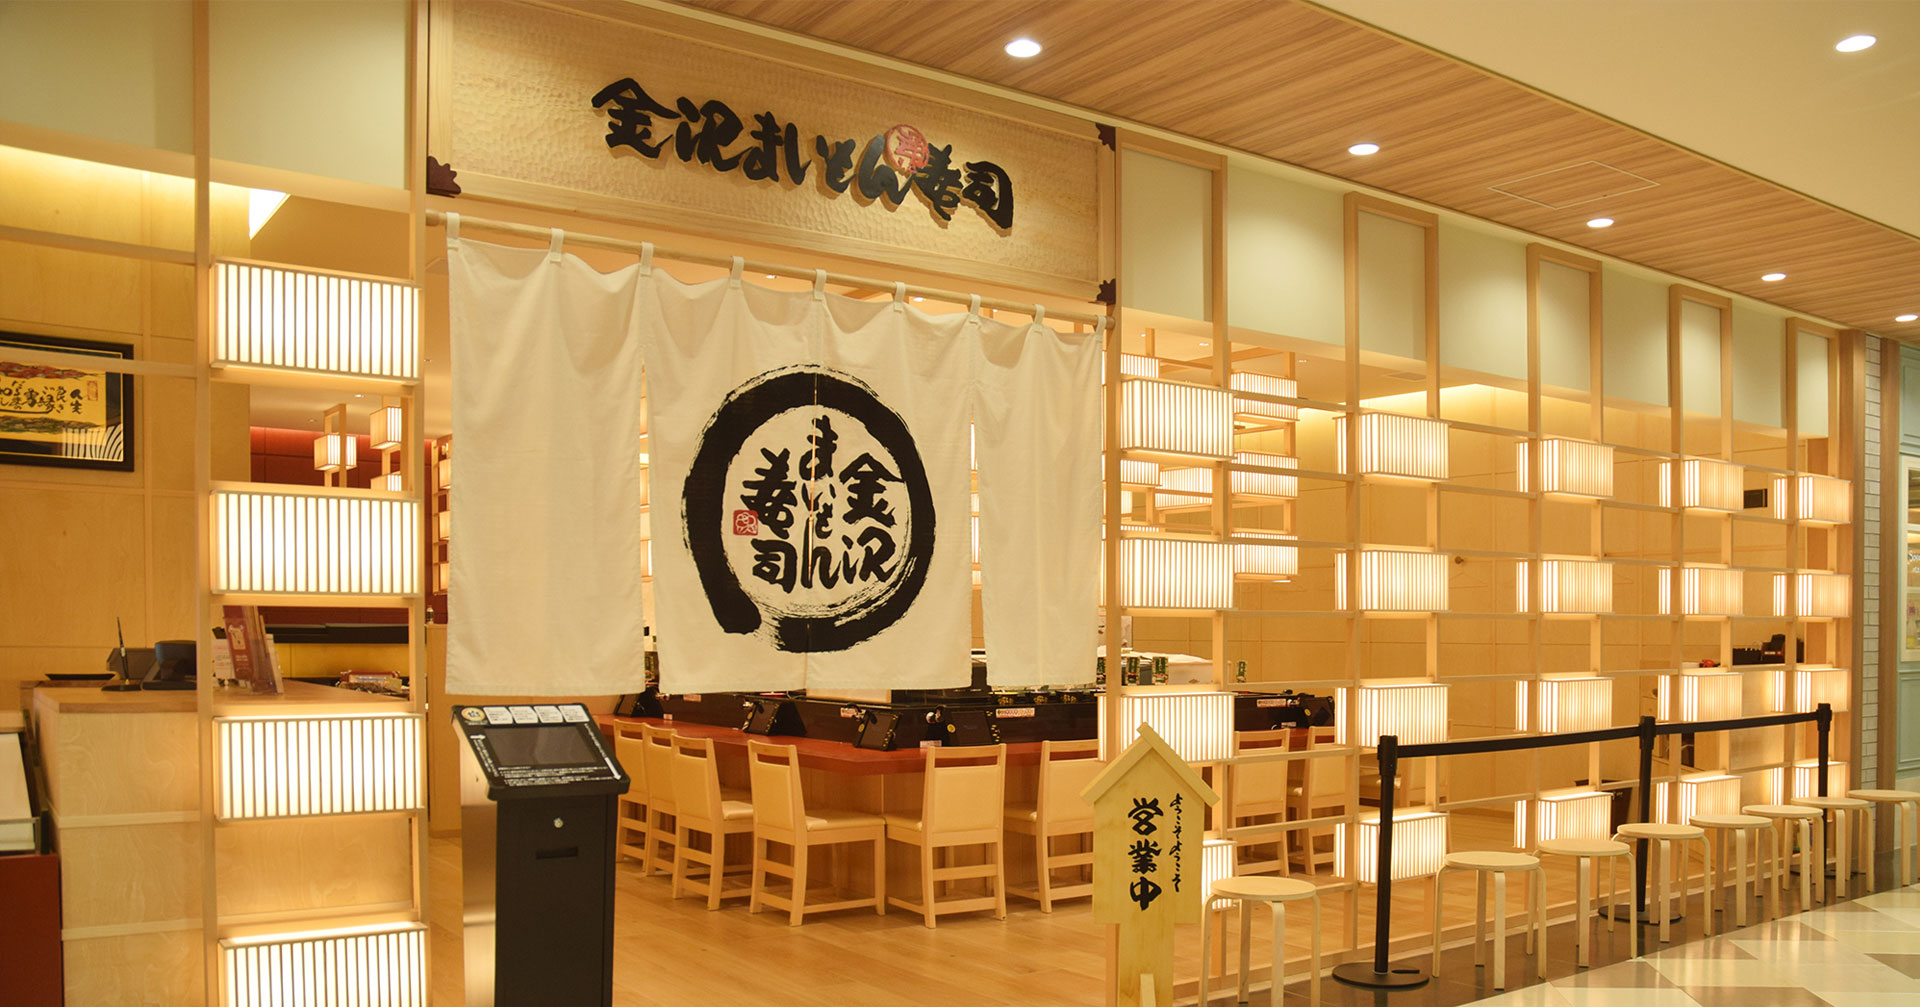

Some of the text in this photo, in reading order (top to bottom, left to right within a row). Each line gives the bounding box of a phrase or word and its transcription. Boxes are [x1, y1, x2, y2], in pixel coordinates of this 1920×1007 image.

[799, 414, 841, 589] まいもん
[839, 452, 904, 583] 金沢
[1127, 797, 1164, 911] 営業中
[1169, 793, 1183, 893] ようこそようこそ
